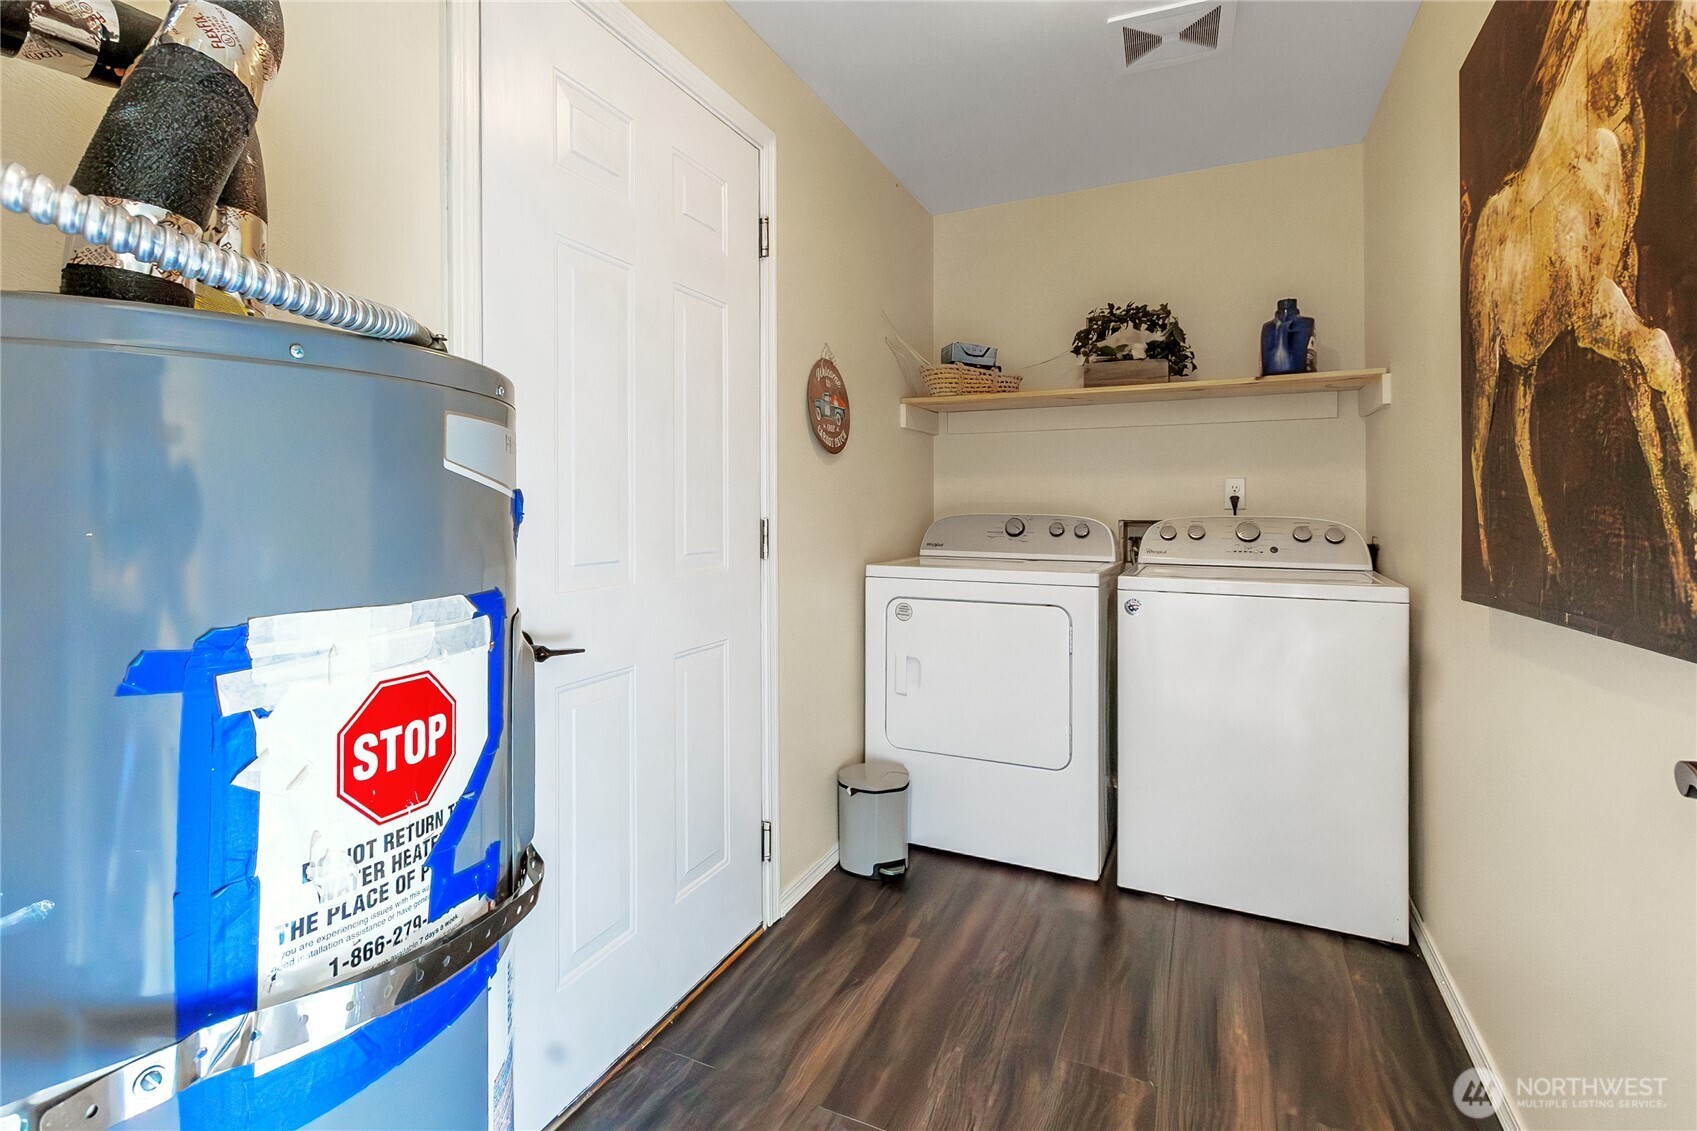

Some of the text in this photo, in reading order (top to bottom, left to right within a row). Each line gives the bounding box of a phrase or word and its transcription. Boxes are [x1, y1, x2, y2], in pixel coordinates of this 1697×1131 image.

[192, 12, 226, 50] FLEXFIX
[352, 713, 447, 781] STOP
[347, 838, 377, 865] OT
[384, 809, 444, 853] RETURN
[392, 832, 442, 873] HEATE
[276, 867, 430, 945] THE PLACE OF P
[299, 940, 314, 951] are
[316, 917, 369, 944] experiencing
[370, 904, 393, 920] issues
[395, 897, 408, 908] with
[409, 890, 421, 901] this
[345, 919, 386, 942] assistance
[387, 914, 395, 922] or
[396, 904, 413, 918] have
[413, 895, 430, 910] gene
[424, 929, 439, 940] days
[444, 914, 458, 927] week
[328, 914, 428, 977] 1-866-279-
